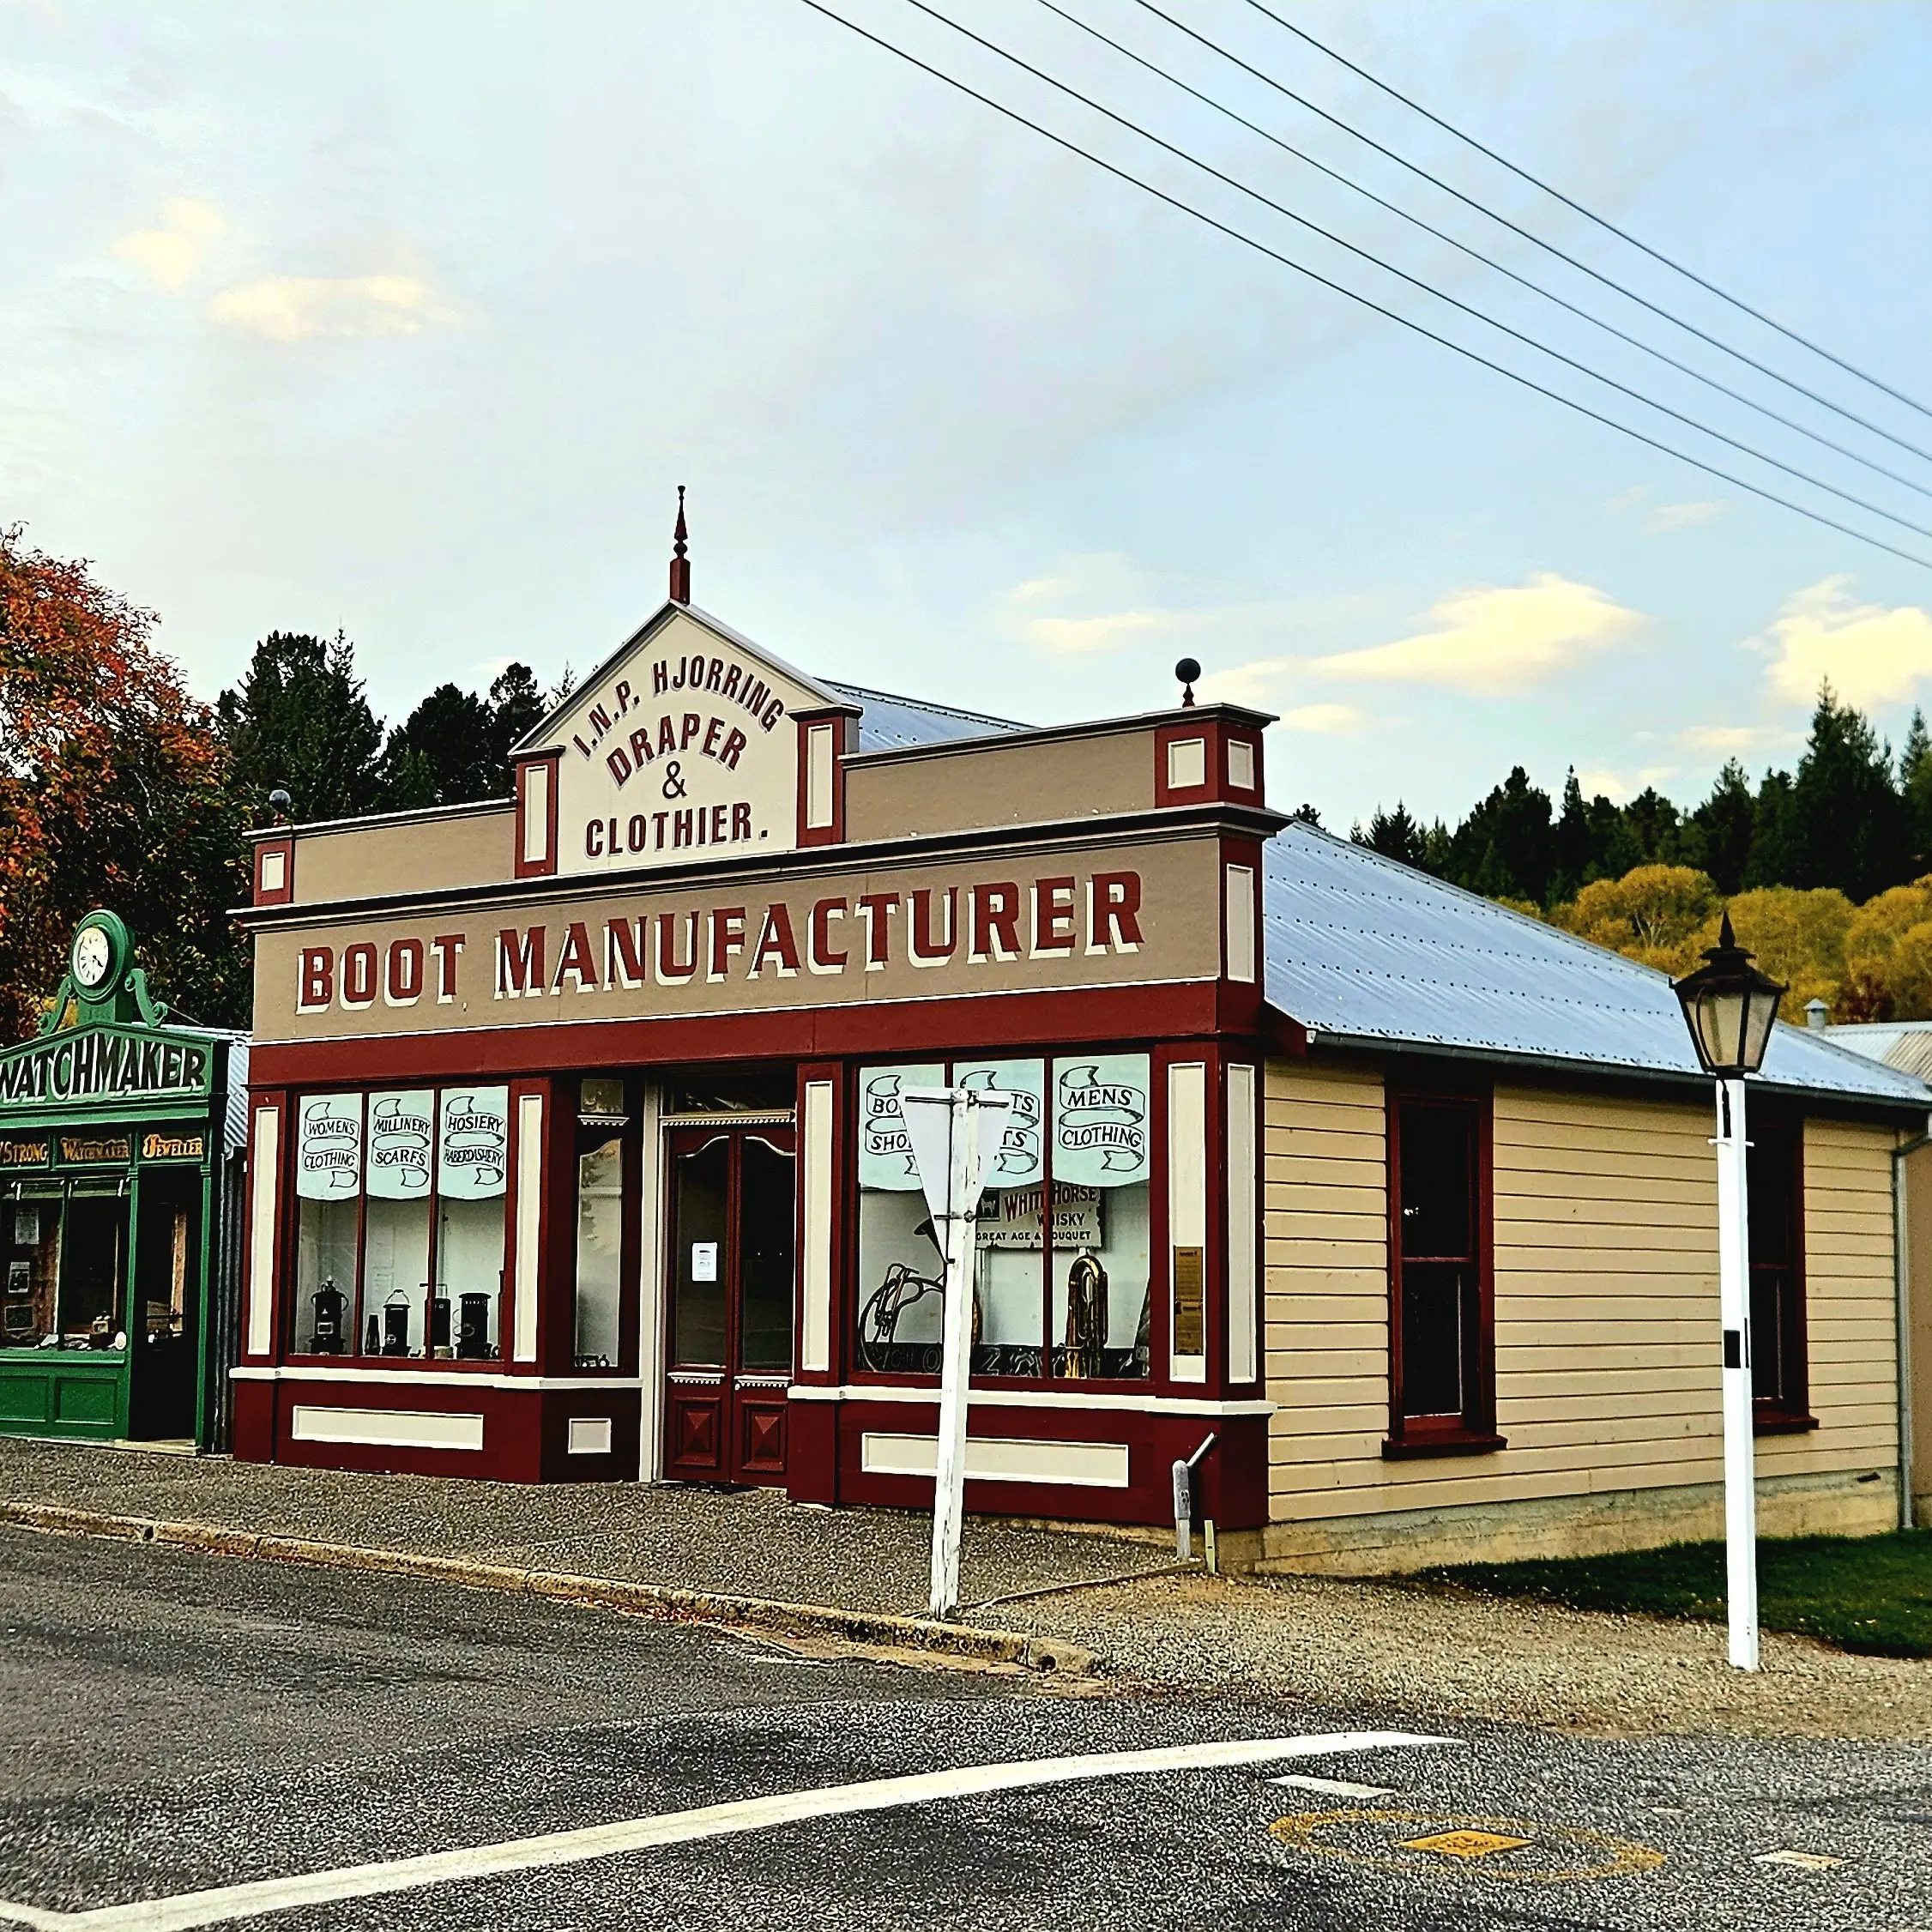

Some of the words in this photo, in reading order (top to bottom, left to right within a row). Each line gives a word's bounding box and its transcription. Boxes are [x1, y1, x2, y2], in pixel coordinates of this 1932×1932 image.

[652, 655, 785, 734] HJORRING
[604, 712, 748, 790] DRAPER
[661, 760, 688, 800] &
[296, 933, 466, 1016] BOOT
[493, 870, 1145, 1000] MANUFACTURER
[0, 1032, 207, 1104] WATCHMAKER
[1067, 1089, 1132, 1108] MENS
[308, 1120, 356, 1136] WOMENS
[373, 1117, 431, 1135] MILLINERY
[447, 1114, 504, 1133] HOSIERY
[142, 1133, 204, 1158] JEWELLER
[1061, 1126, 1143, 1148] CLOTHING
[304, 1152, 356, 1168] CLOTHING
[375, 1148, 427, 1167] SCARFS
[1004, 1189, 1044, 1223] WHIT
[1053, 1180, 1097, 1205] HORSE
[1036, 1212, 1085, 1227] WISKY
[975, 1231, 1007, 1241] GREAT
[1011, 1231, 1031, 1241] AGE
[1052, 1230, 1091, 1241] OUQUET
